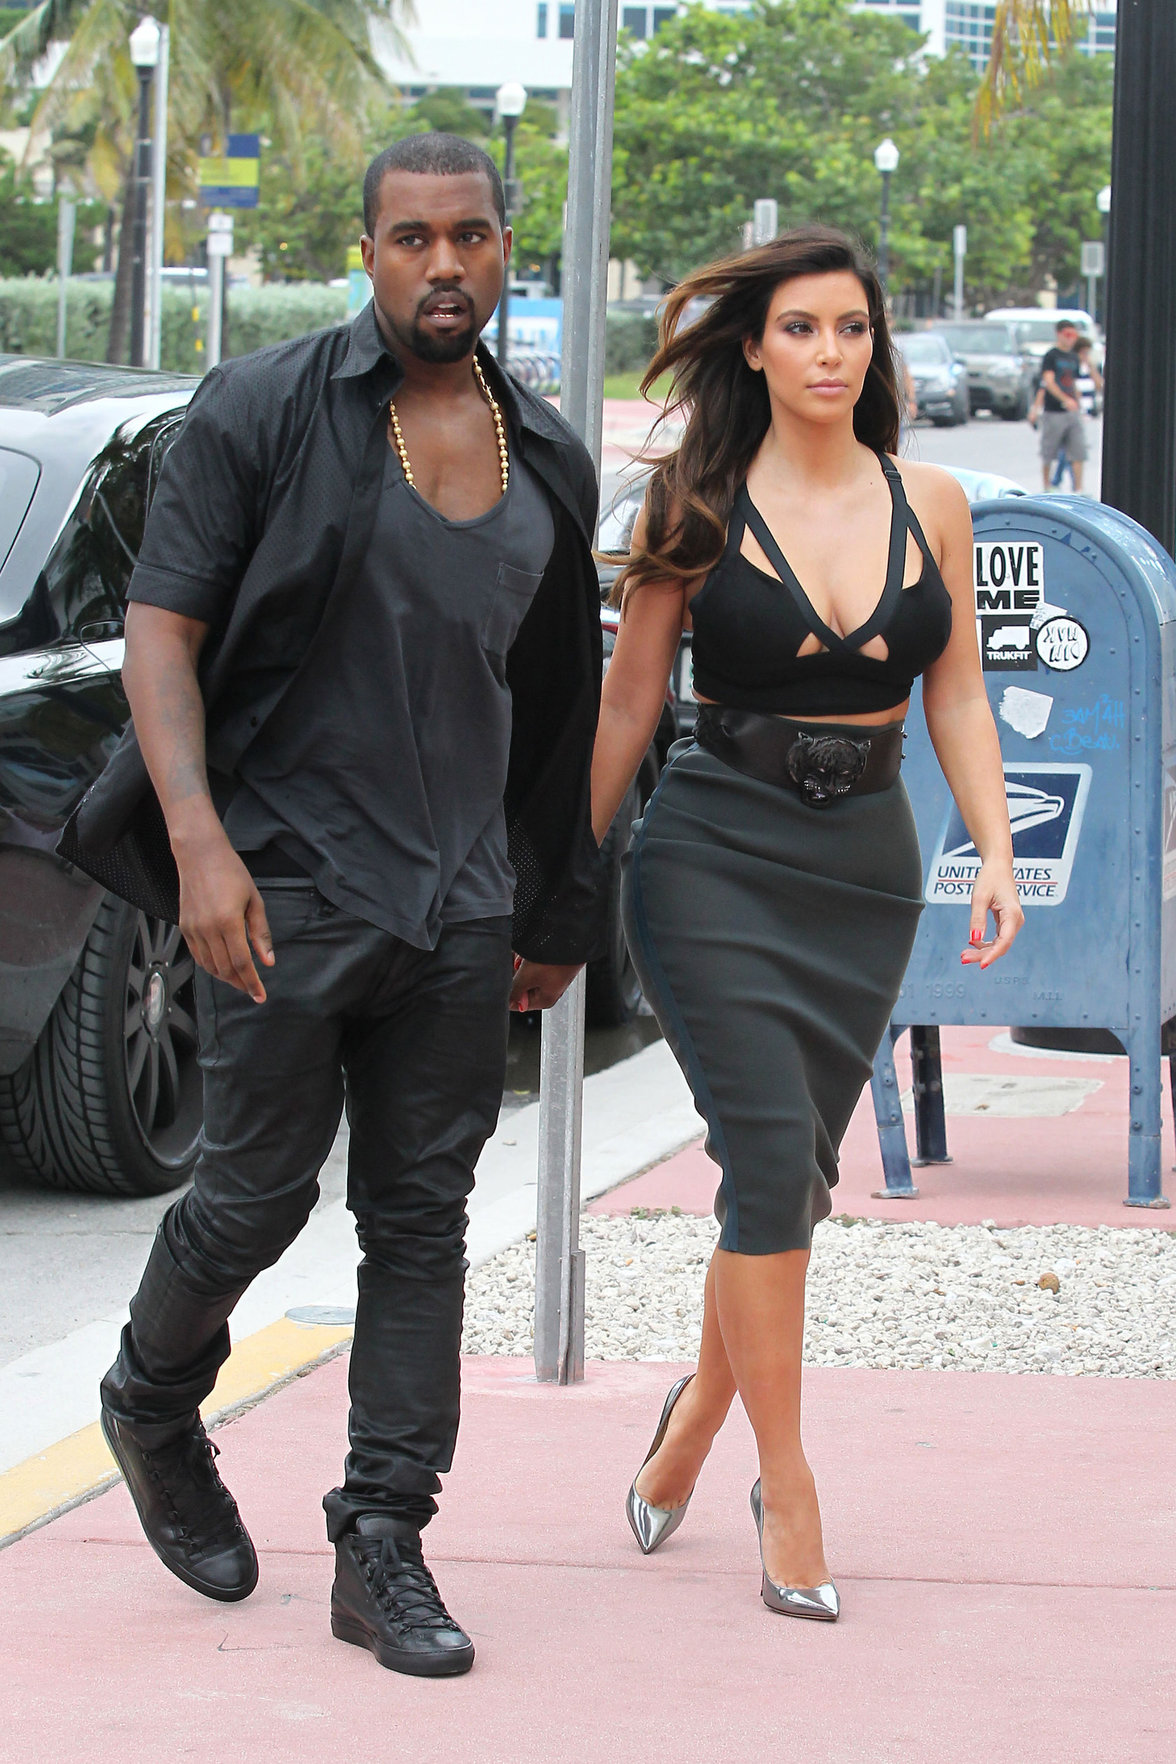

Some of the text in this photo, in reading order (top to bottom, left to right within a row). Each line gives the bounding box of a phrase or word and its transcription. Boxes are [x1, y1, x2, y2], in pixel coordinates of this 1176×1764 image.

[976, 546, 1039, 587] LOVE
[976, 590, 1040, 609] ME
[986, 651, 1033, 660] TRUKFIT
[934, 882, 1056, 897] POST RVICE
